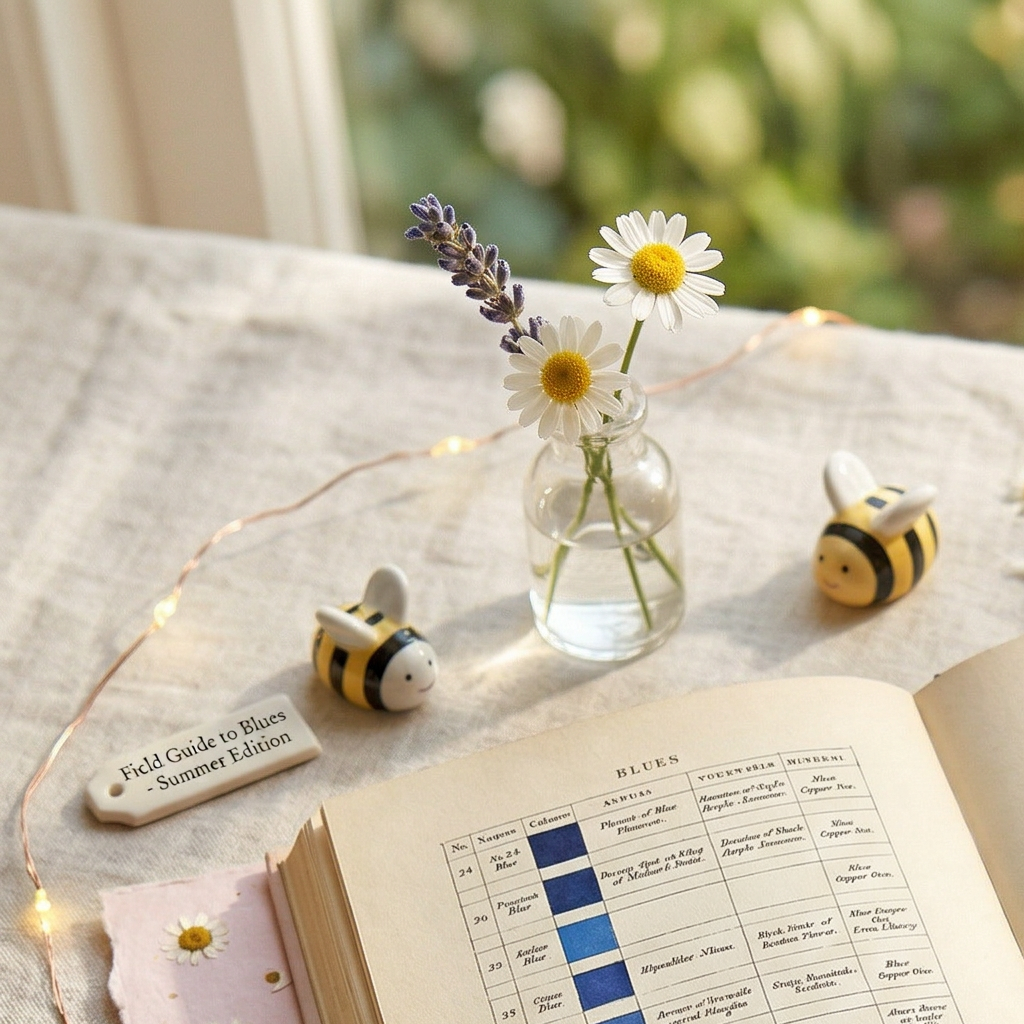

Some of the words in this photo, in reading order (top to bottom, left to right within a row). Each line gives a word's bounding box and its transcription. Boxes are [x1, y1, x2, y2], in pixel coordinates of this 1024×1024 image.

[156, 756, 226, 791] Summer
[227, 732, 292, 764] Edition
[166, 735, 217, 763] Guide
[218, 729, 238, 743] to
[616, 755, 679, 778] BLUES
